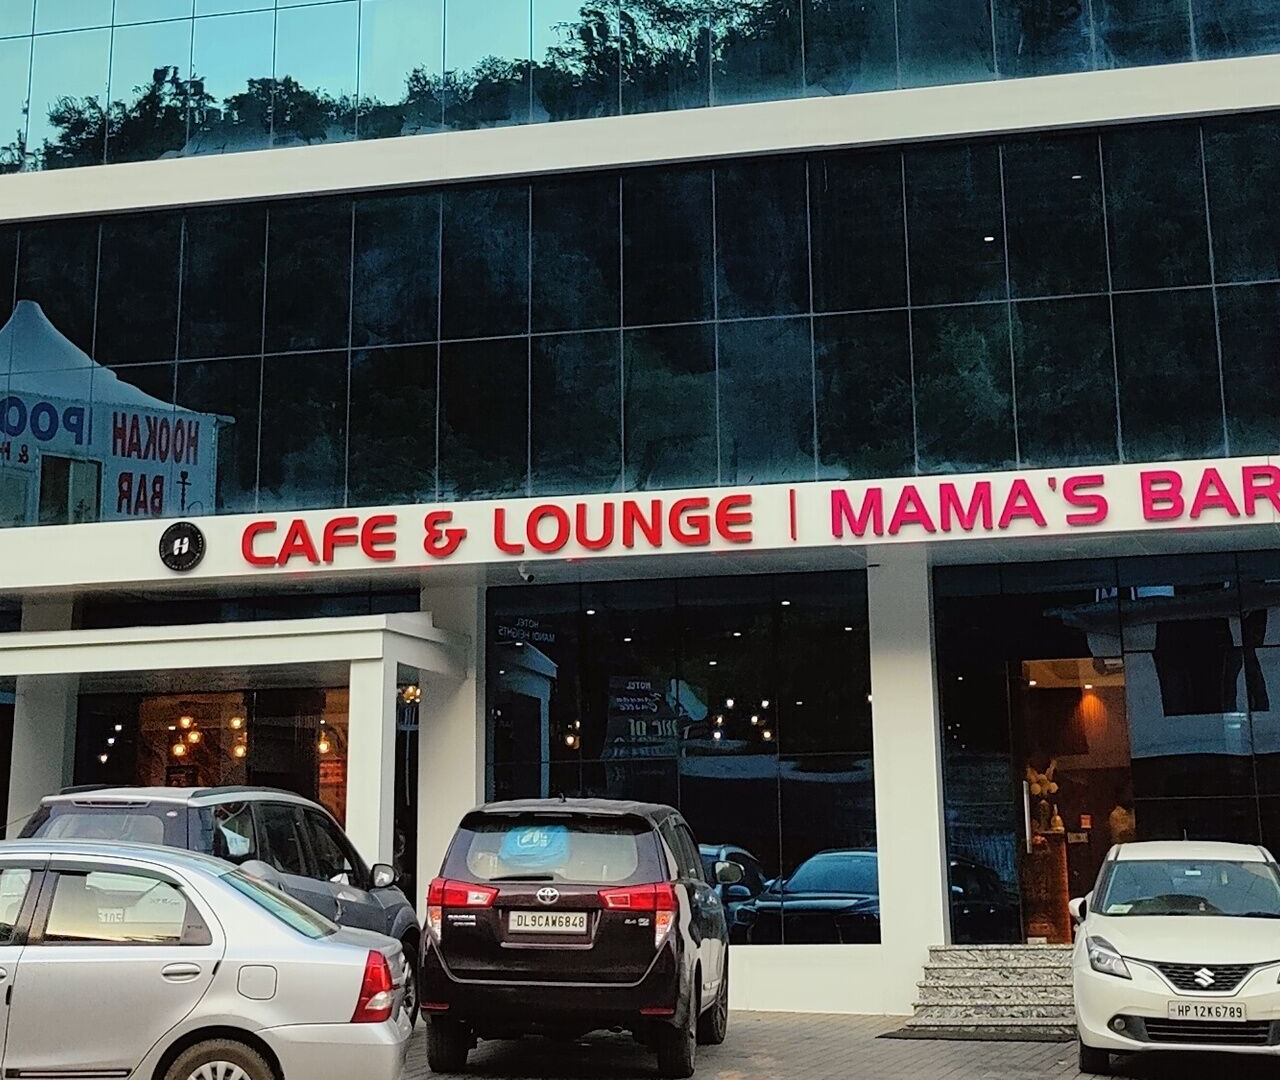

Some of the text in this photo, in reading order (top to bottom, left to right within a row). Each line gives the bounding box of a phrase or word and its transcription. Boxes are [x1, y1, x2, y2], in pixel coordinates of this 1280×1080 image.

[241, 514, 398, 567] CAFE
[422, 510, 467, 558] &
[493, 493, 753, 555] LOUNGE
[830, 474, 1108, 538] MAMA'S
[517, 914, 585, 928] DL9CAW6848
